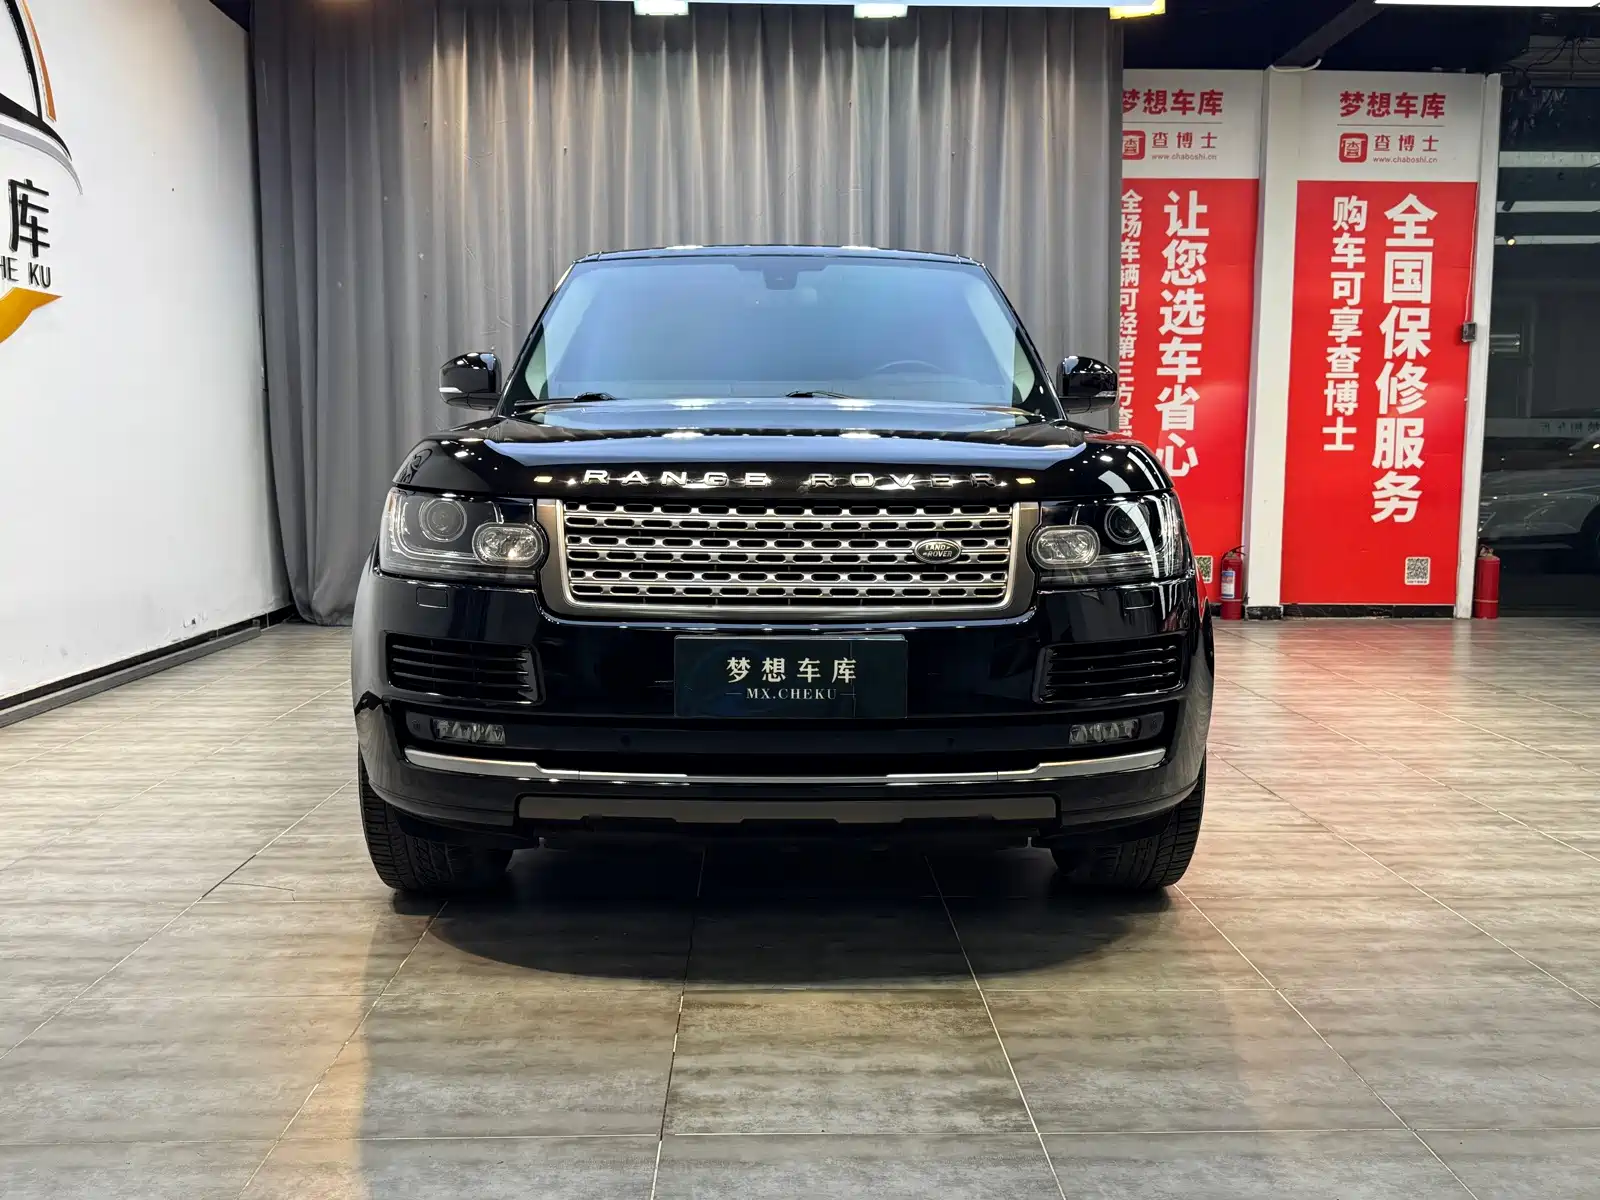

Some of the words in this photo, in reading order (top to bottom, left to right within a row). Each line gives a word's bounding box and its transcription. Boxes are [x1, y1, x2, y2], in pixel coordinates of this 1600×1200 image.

[1122, 89, 1224, 116] 梦想车库
[1339, 91, 1447, 119] 梦想车库
[1151, 132, 1218, 149] 查博士
[1373, 134, 1440, 152] 查博士
[1151, 152, 1218, 161] www.chaboshi.cn
[1373, 155, 1438, 164] www.chaboshi.cn
[8, 178, 51, 258] 库
[28, 262, 51, 288] KU
[1118, 189, 1144, 437] 全场车辆可经第三方查
[1322, 195, 1368, 451] 购车可享查博士
[1154, 190, 1210, 477] 让您选车省心
[1371, 193, 1438, 523] 全国保修服务
[583, 469, 769, 488] RANGE
[808, 473, 997, 489] ROVER
[726, 656, 857, 683] 梦想车库
[746, 687, 838, 700] MX.CHEKU
